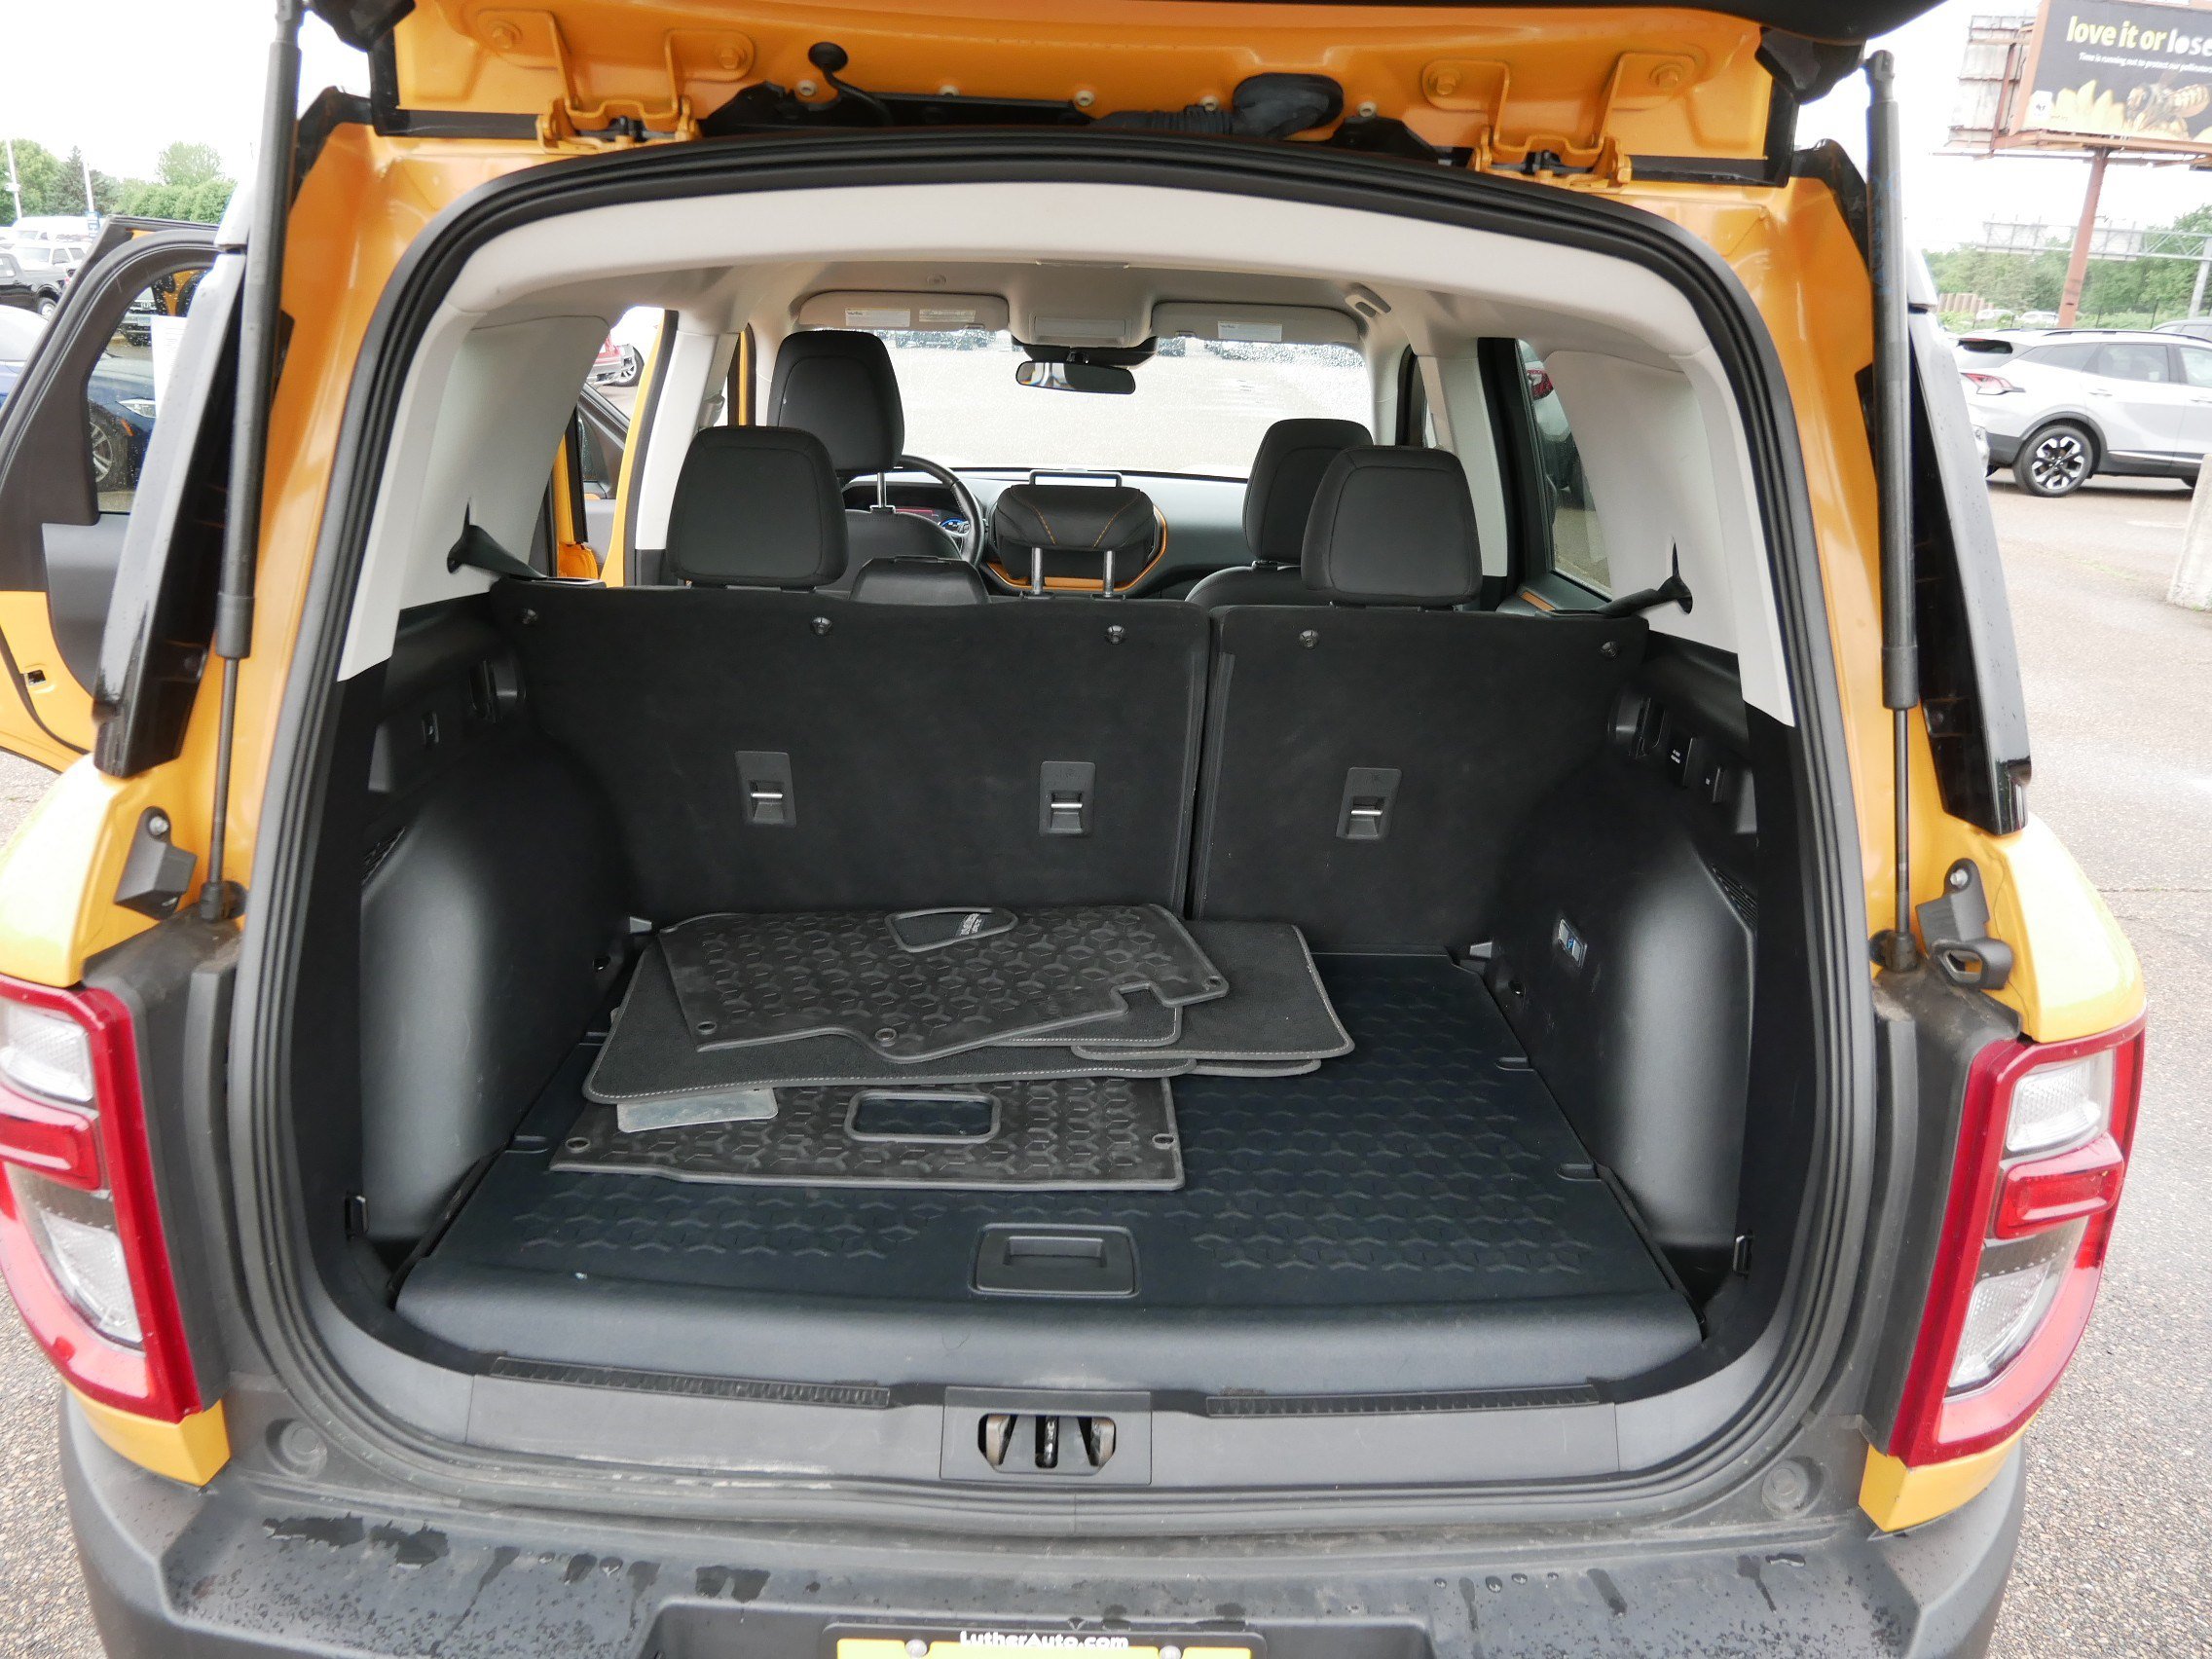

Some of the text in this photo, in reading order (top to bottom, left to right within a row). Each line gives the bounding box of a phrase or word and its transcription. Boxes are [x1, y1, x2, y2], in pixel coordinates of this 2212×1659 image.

[2066, 15, 2117, 47] love
[2119, 20, 2139, 49] it
[2140, 29, 2168, 51] or
[960, 1631, 1128, 1649] LutherAuto.com
